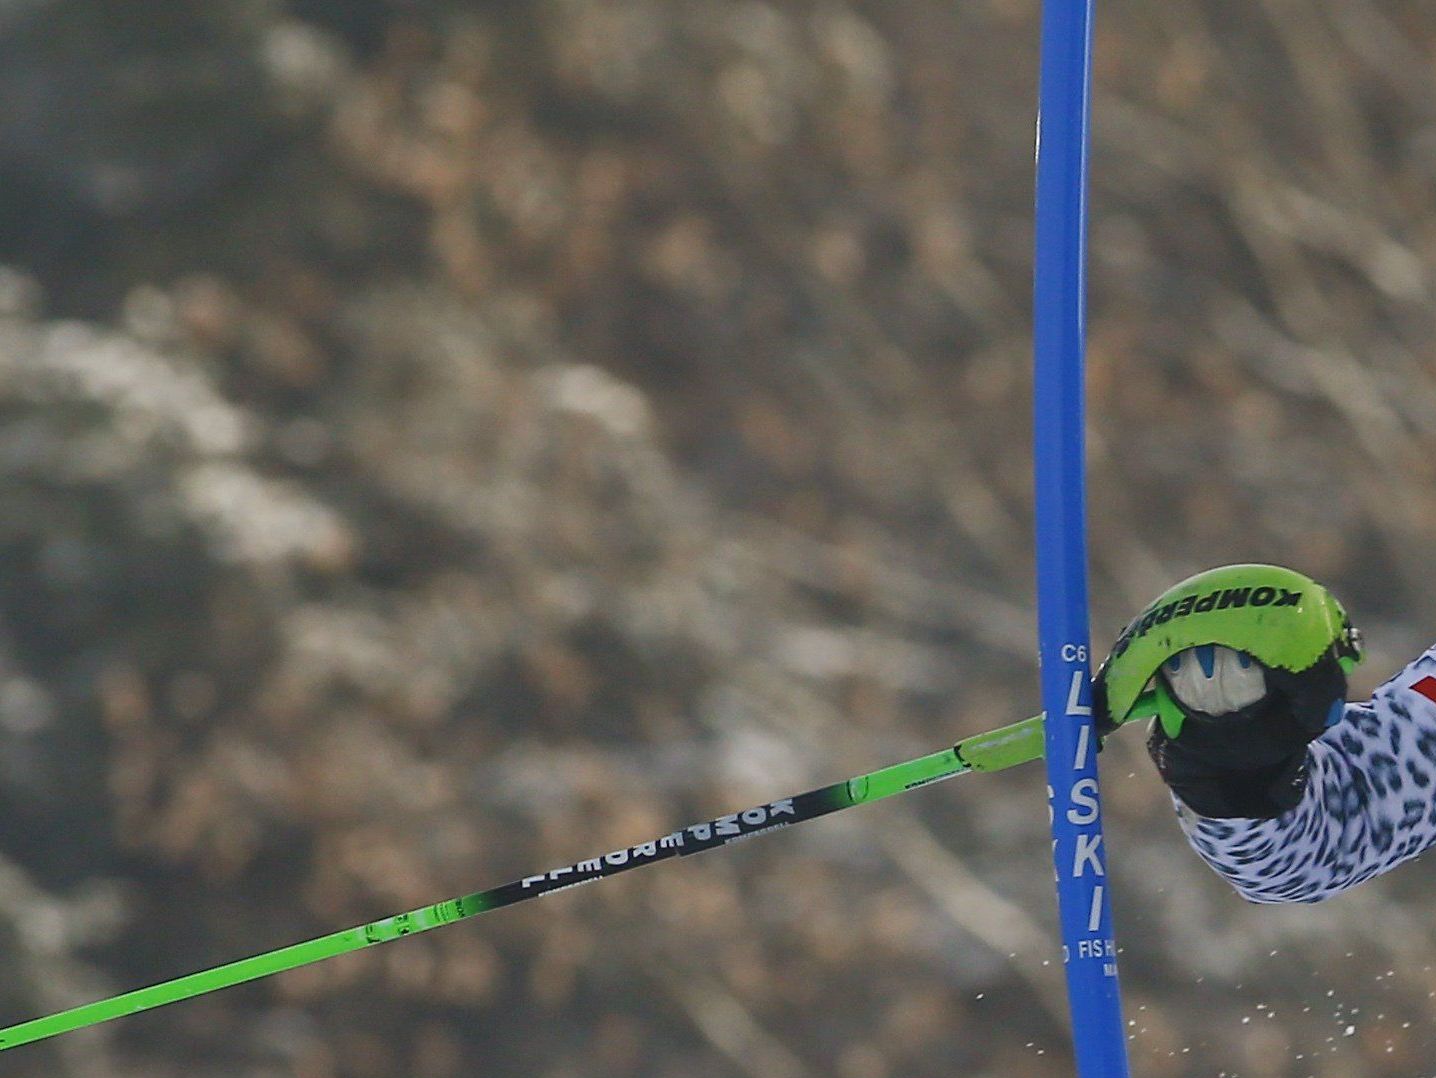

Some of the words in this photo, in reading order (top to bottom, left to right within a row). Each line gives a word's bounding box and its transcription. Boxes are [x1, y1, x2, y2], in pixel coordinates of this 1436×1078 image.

[1061, 644, 1087, 663] C6
[521, 799, 796, 888] KOMPERDELL
[1065, 671, 1105, 932] LISKI
